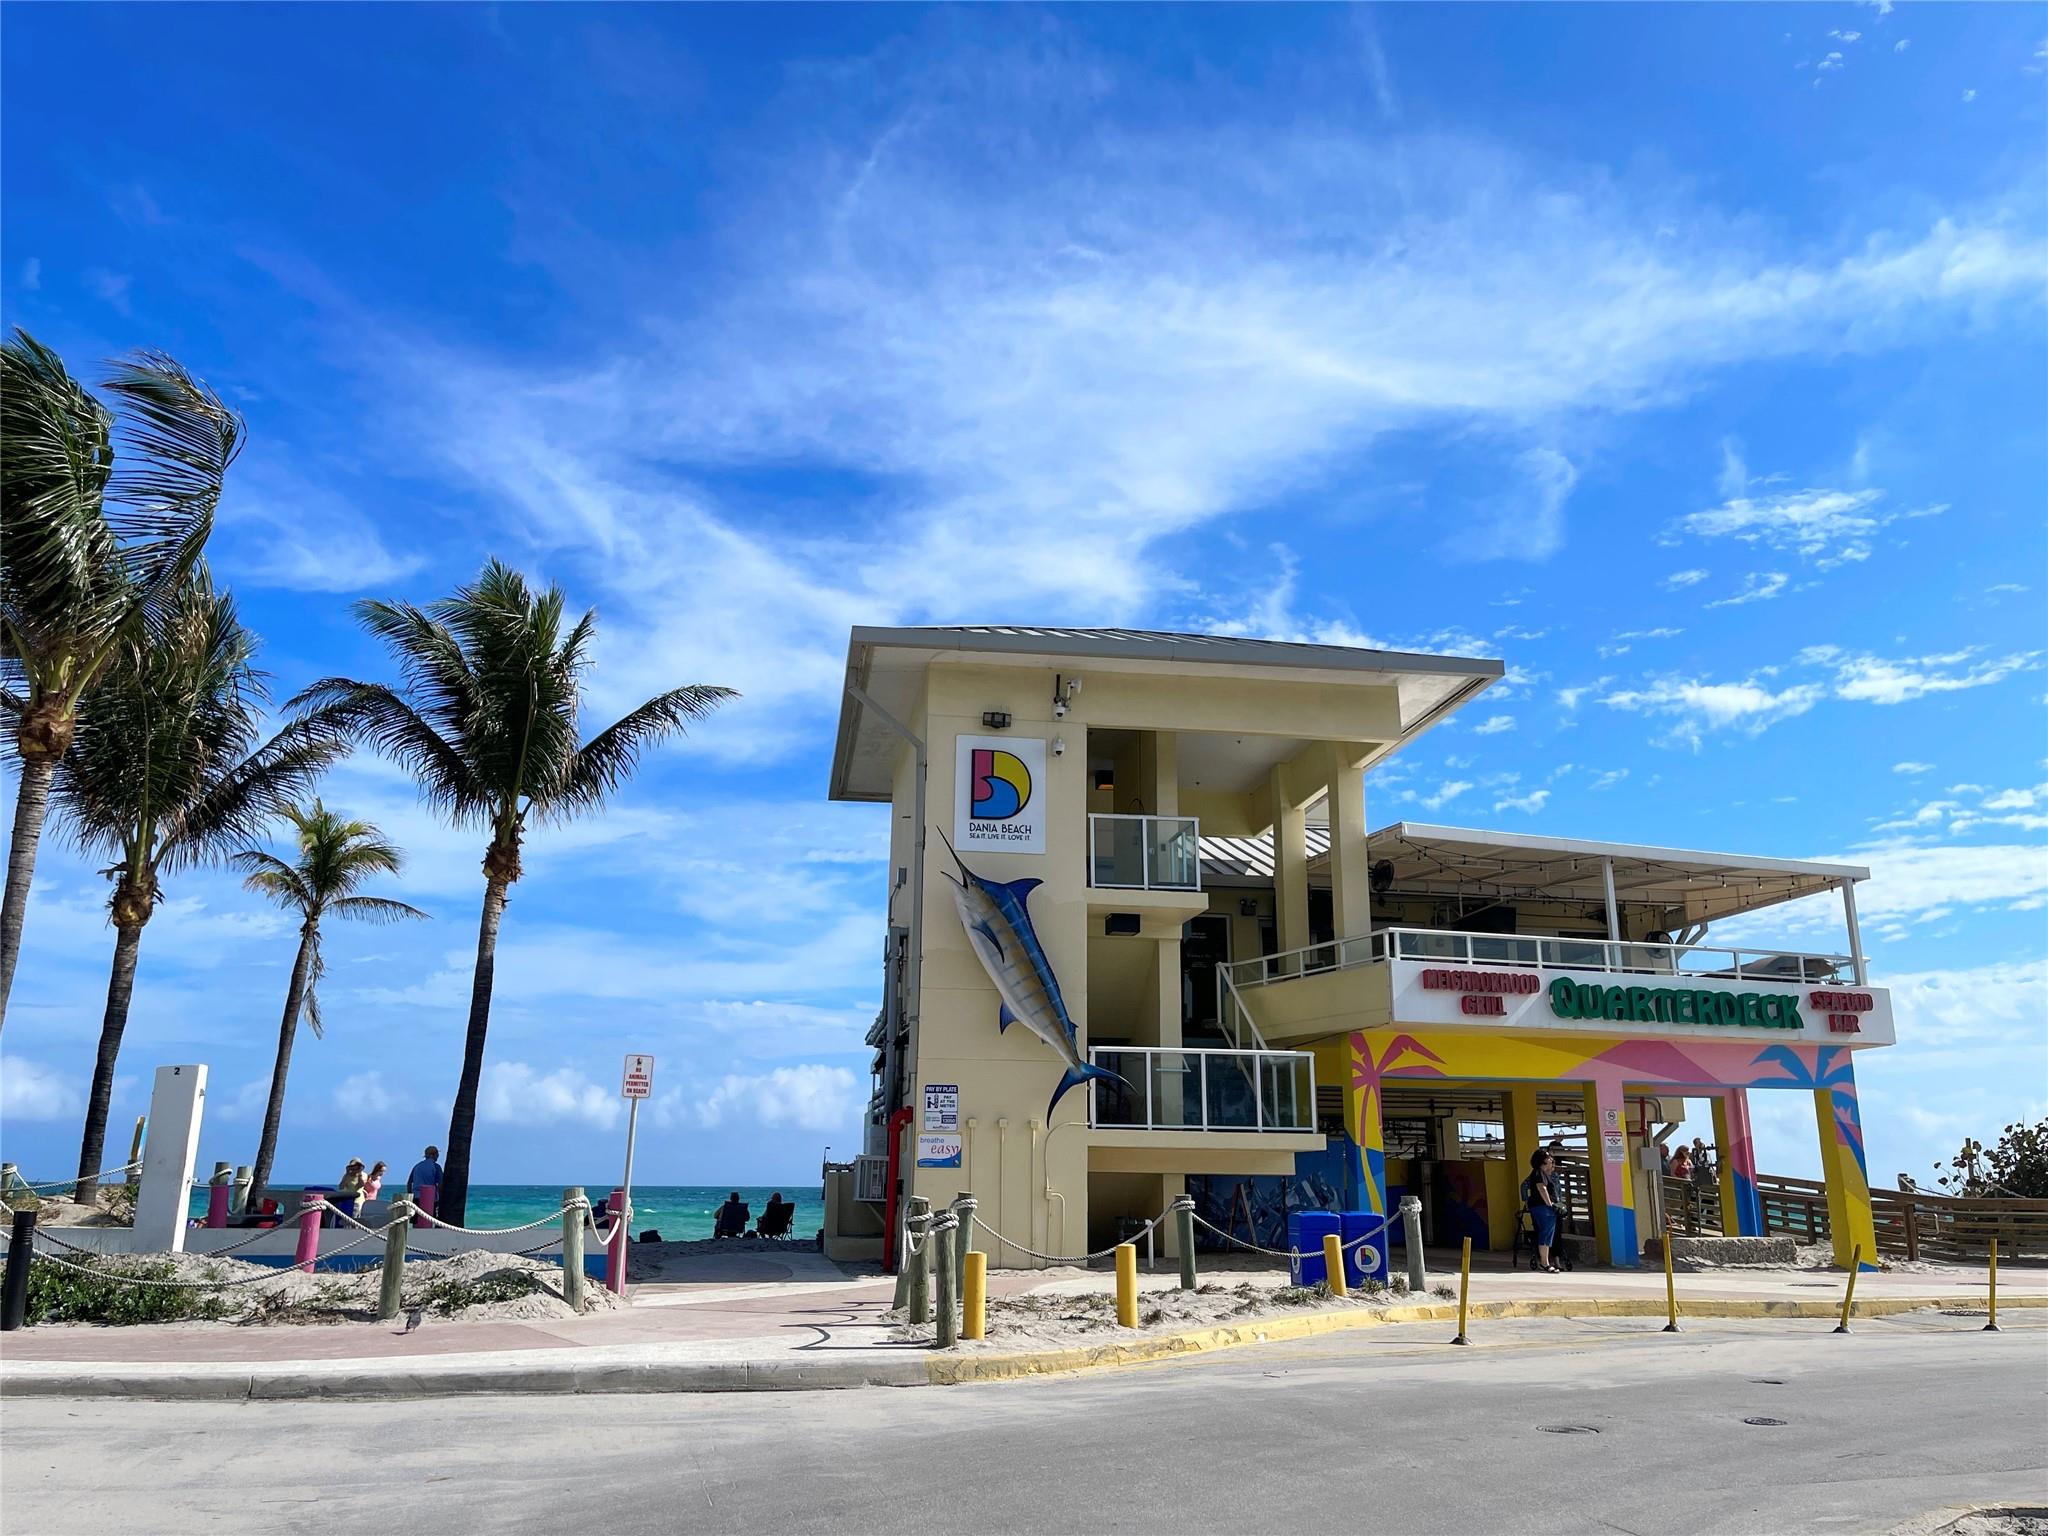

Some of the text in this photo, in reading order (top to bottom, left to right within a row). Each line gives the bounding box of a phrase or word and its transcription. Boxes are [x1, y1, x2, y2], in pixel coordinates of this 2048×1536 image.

[969, 822, 1032, 834] DANIA BEACH
[1423, 969, 1540, 994] NEIGHBORHOOD
[1461, 995, 1506, 1016] GRILL
[1550, 977, 1804, 1029] QUARTERDECK
[1810, 991, 1873, 1011] SEAFOOD
[1828, 1014, 1861, 1033] BAR
[174, 1067, 181, 1076] 2
[920, 1136, 945, 1144] breathe
[930, 1145, 959, 1158] easy
